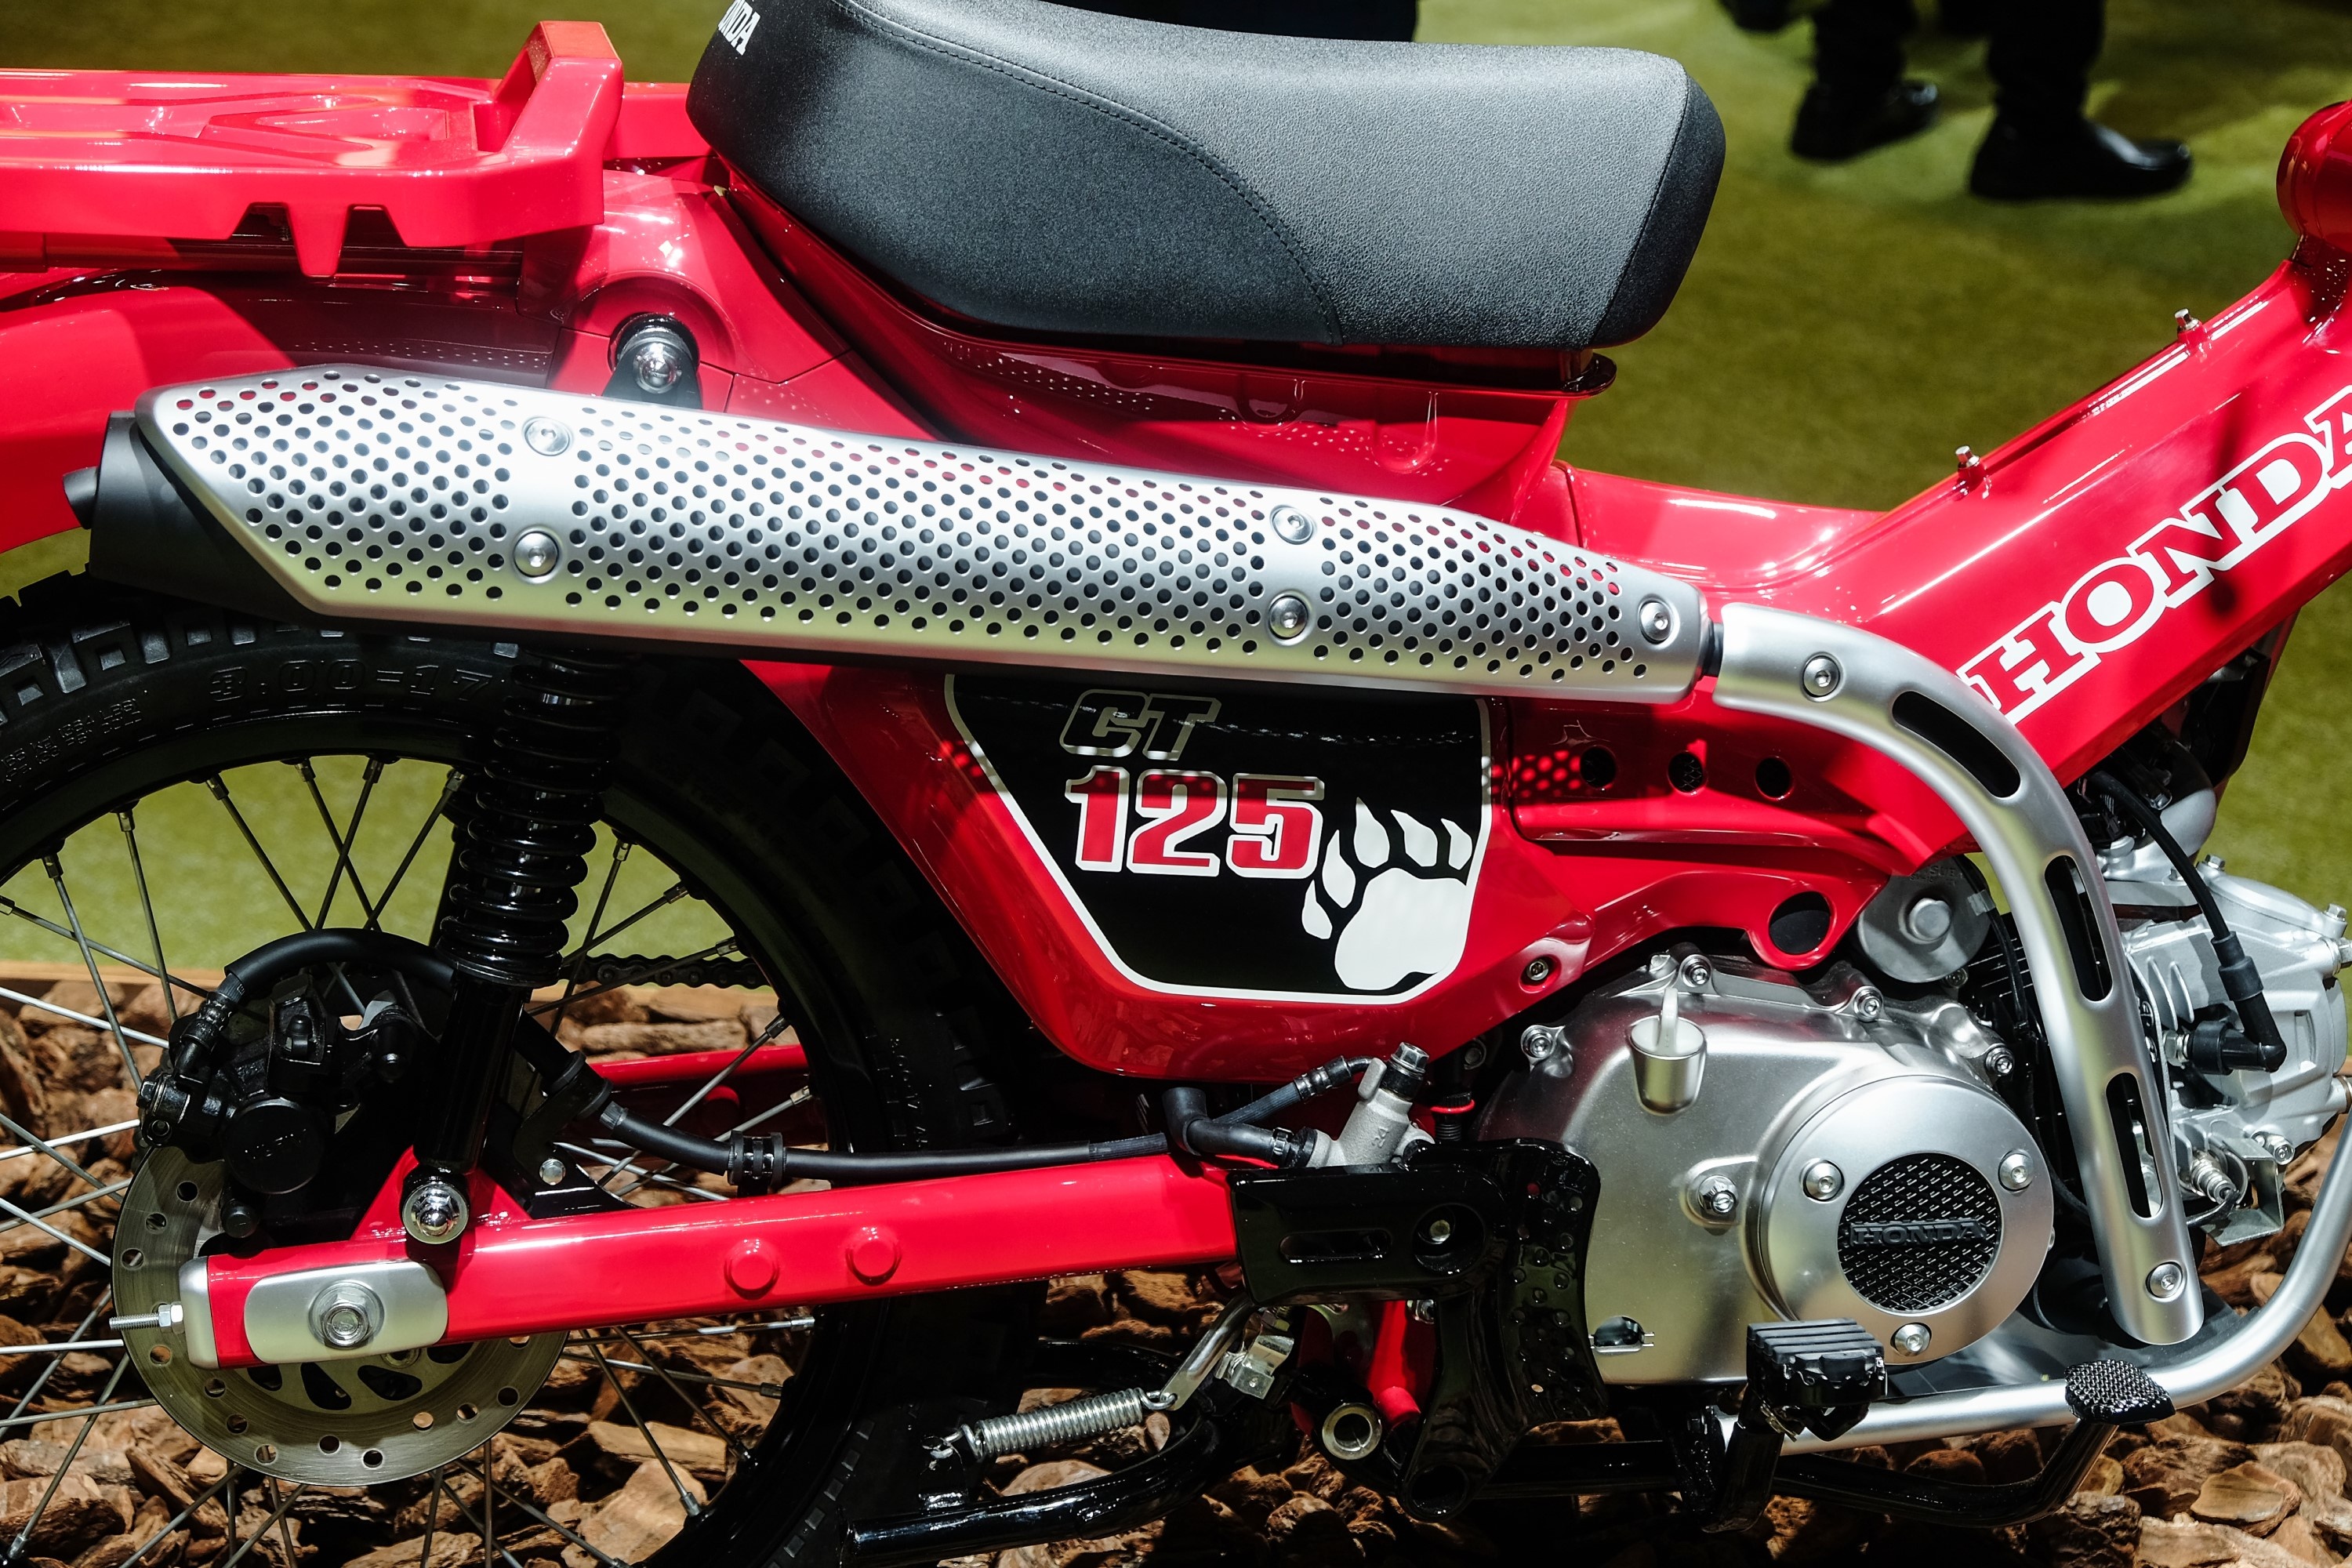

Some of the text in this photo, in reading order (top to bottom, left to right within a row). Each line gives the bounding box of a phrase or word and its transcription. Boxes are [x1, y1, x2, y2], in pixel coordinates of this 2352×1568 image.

[1059, 688, 1222, 760] CT
[1065, 765, 1325, 880] 125
[1852, 1220, 1987, 1247] HONDA
